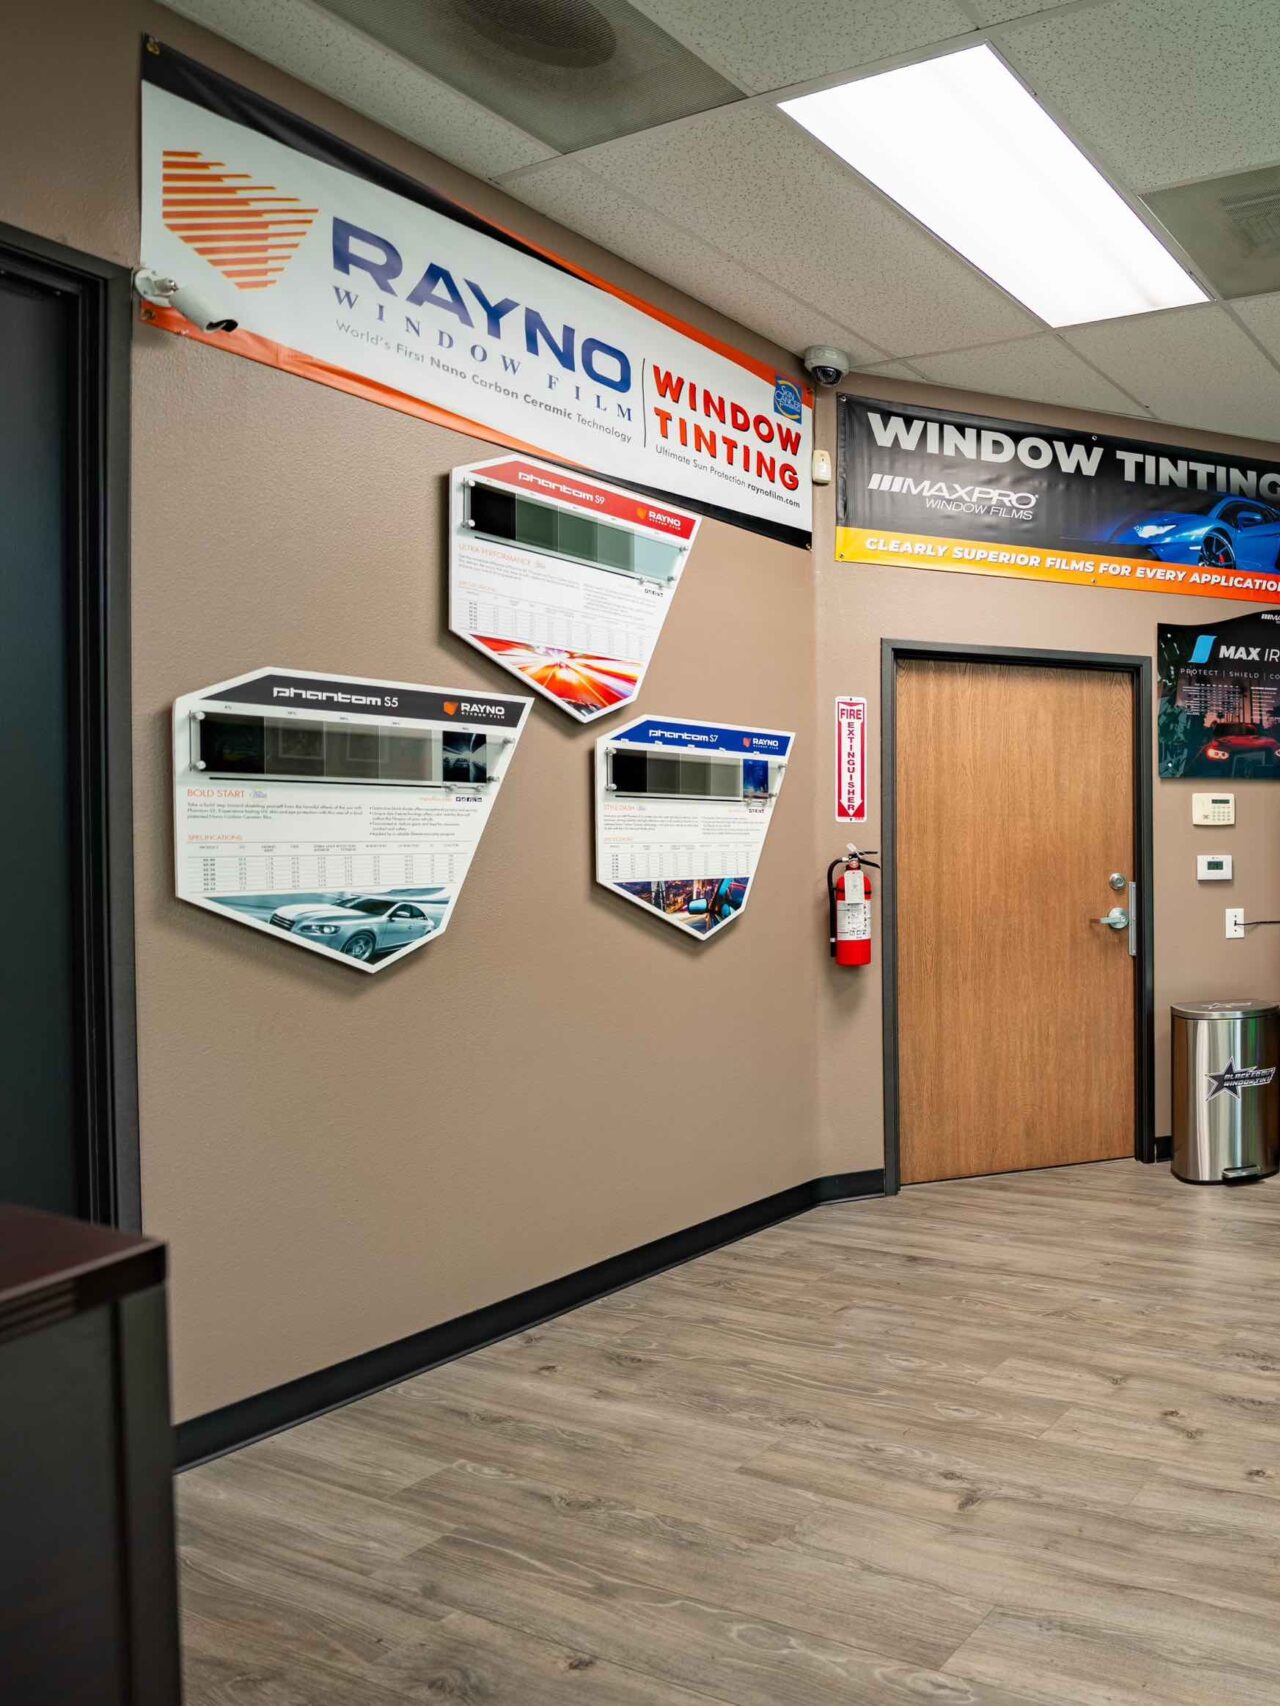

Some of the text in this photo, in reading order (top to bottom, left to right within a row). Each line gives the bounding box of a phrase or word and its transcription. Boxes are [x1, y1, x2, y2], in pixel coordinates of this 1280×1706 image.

[332, 215, 632, 394] RAYNO
[333, 285, 634, 423] WINDOW FILM
[335, 318, 632, 444] World's First Nano Carbon Ceramic Technology
[652, 364, 802, 456] WINDOW
[653, 406, 800, 491] TINTING
[866, 411, 1104, 477] WINDOW
[518, 471, 605, 505] phantom S9
[655, 444, 801, 509] Ultimate Sun Protection raynofilm.com
[900, 477, 1039, 510] MAXPRO
[925, 498, 1033, 521] WINDOW FILMS
[648, 510, 682, 528] RAYNO
[865, 537, 949, 557] CLEARLY
[952, 546, 1041, 567] SUPERIOR
[1045, 557, 1096, 573] FILMS
[1098, 562, 1132, 577] FOR
[1135, 566, 1188, 583] EVERY
[1218, 645, 1280, 662] MAX IR
[1180, 668, 1219, 677] PROTECT
[1229, 671, 1260, 679] SHIELD
[273, 686, 399, 708] phantom S5
[460, 702, 505, 715] RAYNO
[840, 708, 862, 720] FIRE
[648, 729, 719, 743] phantom S7
[752, 737, 779, 747] RAYNO
[847, 721, 856, 811] EXTINGUISHER
[187, 789, 214, 799] BOLD
[216, 789, 245, 799] START
